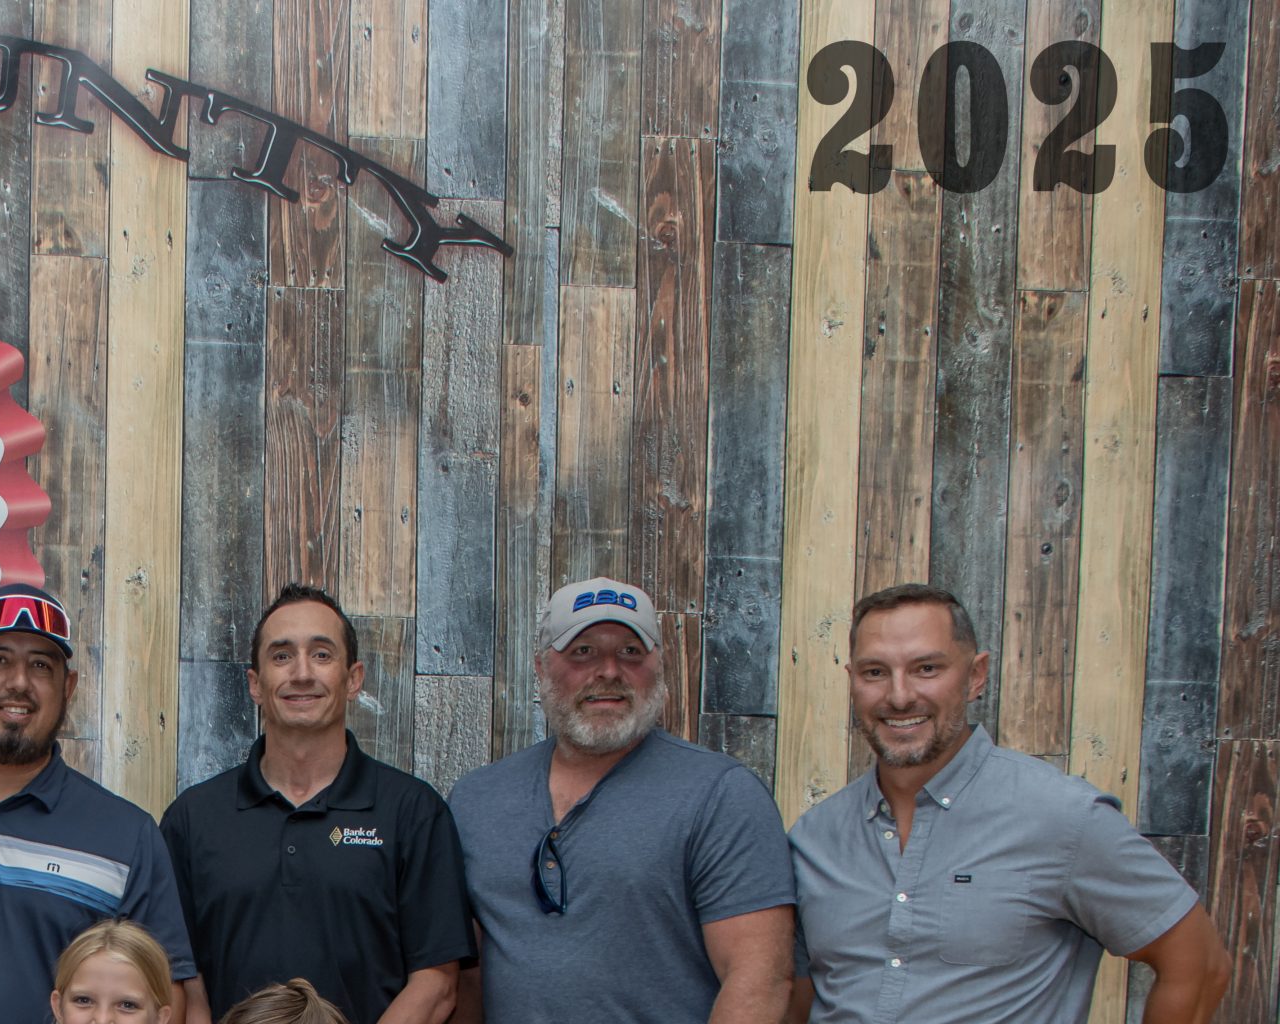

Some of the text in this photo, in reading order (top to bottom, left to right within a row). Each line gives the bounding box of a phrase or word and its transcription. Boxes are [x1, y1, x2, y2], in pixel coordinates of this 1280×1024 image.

[343, 827, 377, 837] Bank of
[343, 836, 384, 846] Colorado
